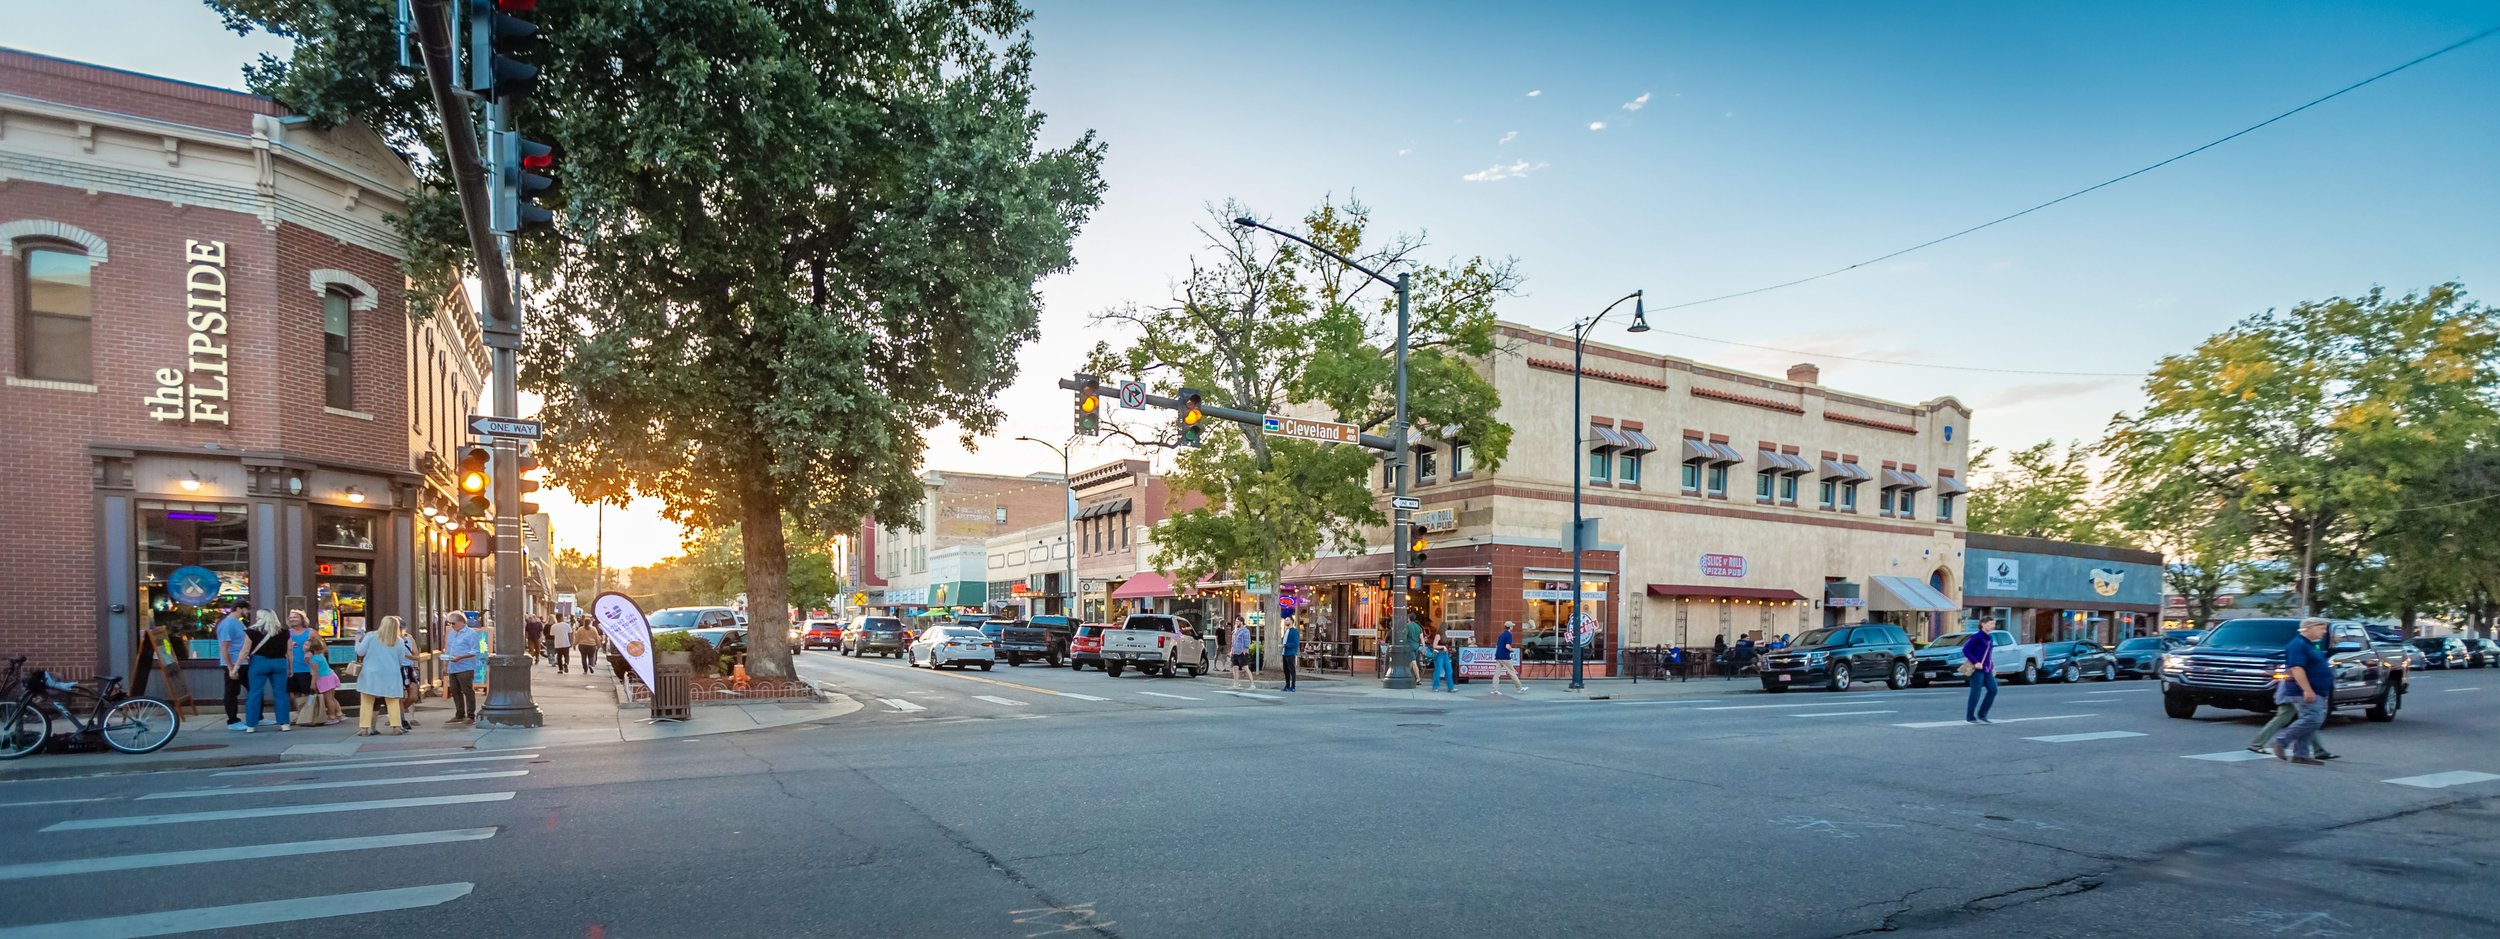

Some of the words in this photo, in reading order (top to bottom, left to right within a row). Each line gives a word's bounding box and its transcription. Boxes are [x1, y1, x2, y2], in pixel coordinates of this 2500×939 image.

[186, 239, 230, 426] FLIPSIDE
[144, 368, 185, 422] the
[490, 422, 511, 432] ONE
[513, 424, 534, 433] WAY
[1279, 422, 1285, 431] N
[1286, 419, 1339, 440] Cleveland
[1346, 426, 1355, 434] Ave
[1346, 434, 1357, 442] 400
[1438, 509, 1452, 521] ROLL
[1437, 520, 1453, 530] PUB
[1706, 556, 1723, 567] SLICE
[1729, 556, 1742, 567] ROLL
[1706, 567, 1727, 576] PIZZA
[1727, 568, 1742, 576] PUB
[622, 617, 638, 628] TOWN
[1474, 653, 1493, 661] LUNCH
